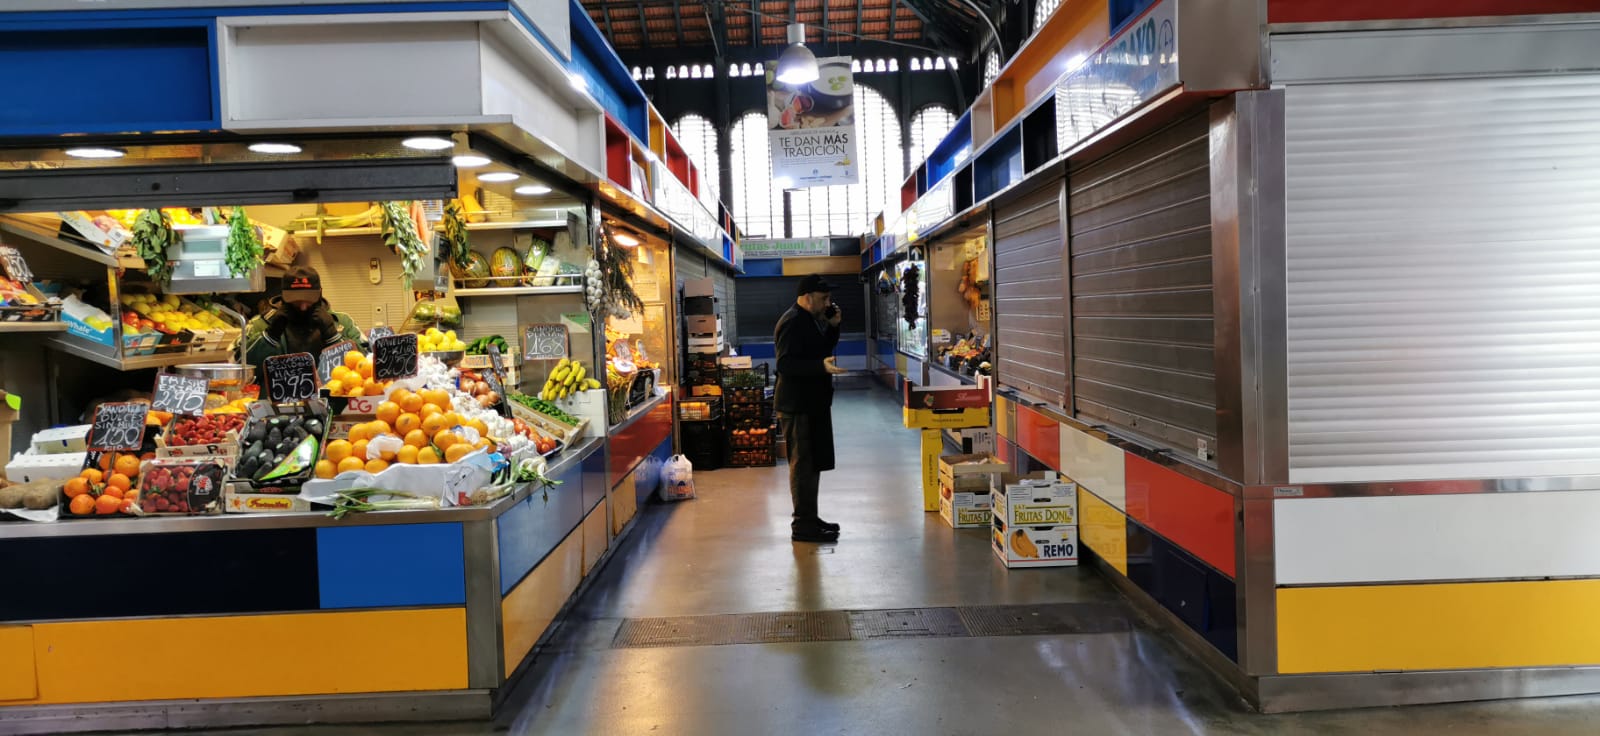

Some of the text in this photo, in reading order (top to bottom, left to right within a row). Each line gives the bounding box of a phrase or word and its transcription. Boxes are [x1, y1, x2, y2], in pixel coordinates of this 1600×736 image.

[779, 136, 791, 147] TE
[794, 135, 820, 147] DAN
[823, 131, 849, 145] MÁS
[271, 372, 315, 400] 5'95
[95, 421, 113, 429] SIN
[958, 512, 983, 522] FRUTAS
[1014, 511, 1043, 522] FRUTAS
[1043, 544, 1074, 558] REMO
